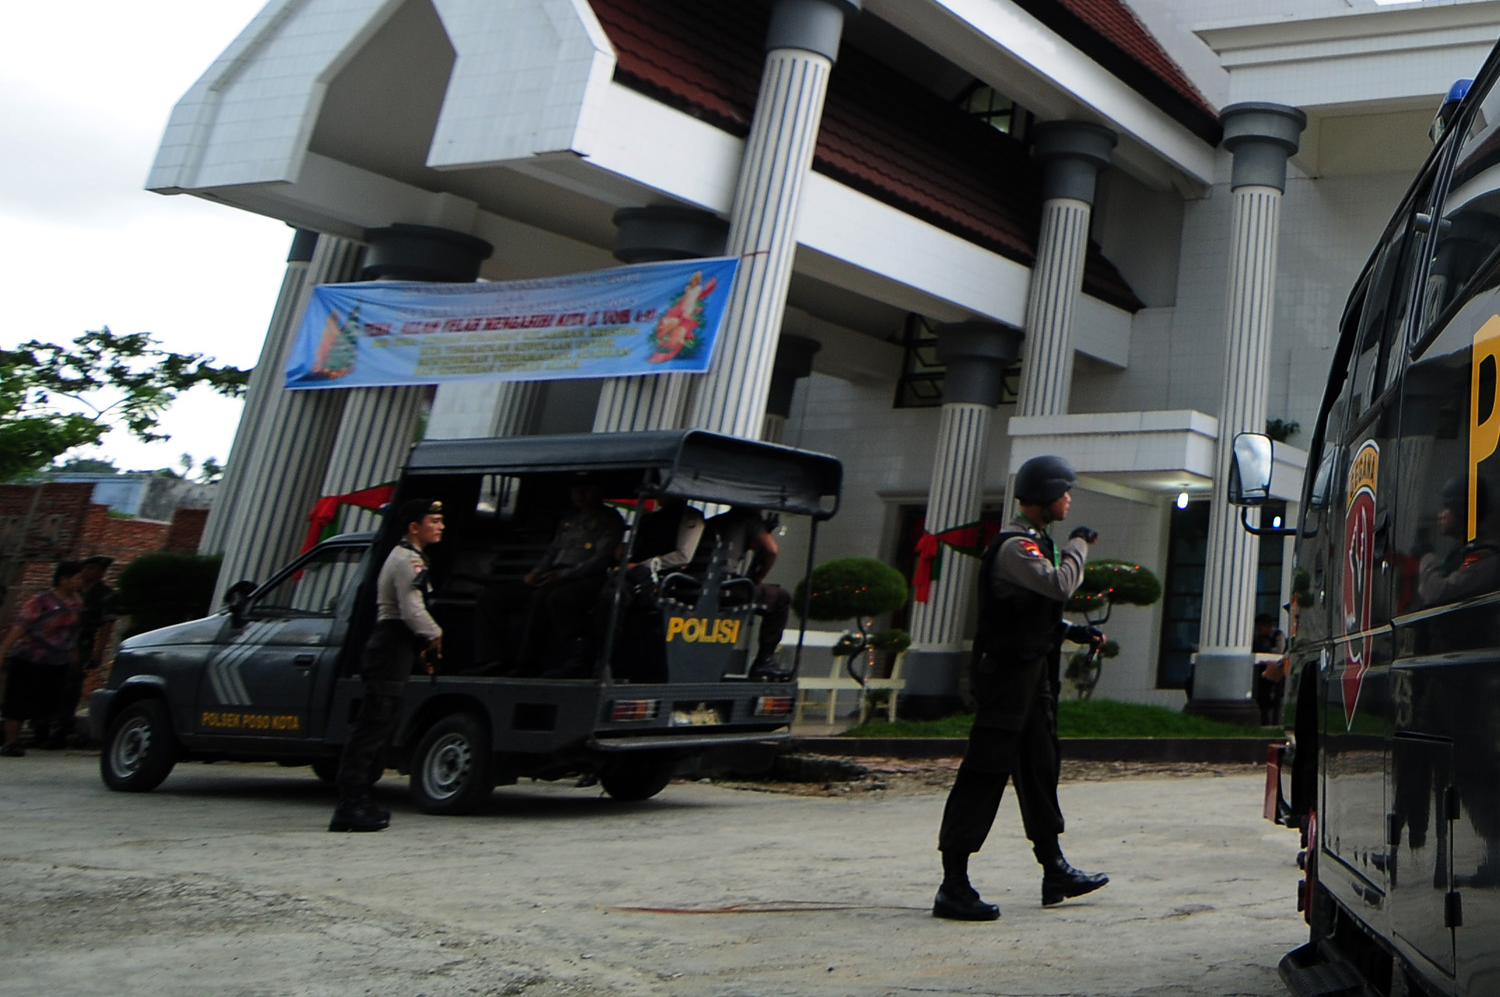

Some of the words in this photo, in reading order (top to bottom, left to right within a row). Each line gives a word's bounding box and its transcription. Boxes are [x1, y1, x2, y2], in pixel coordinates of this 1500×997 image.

[665, 616, 741, 643] POLISI
[202, 711, 240, 728] POLSEK
[271, 715, 299, 731] KOTA
